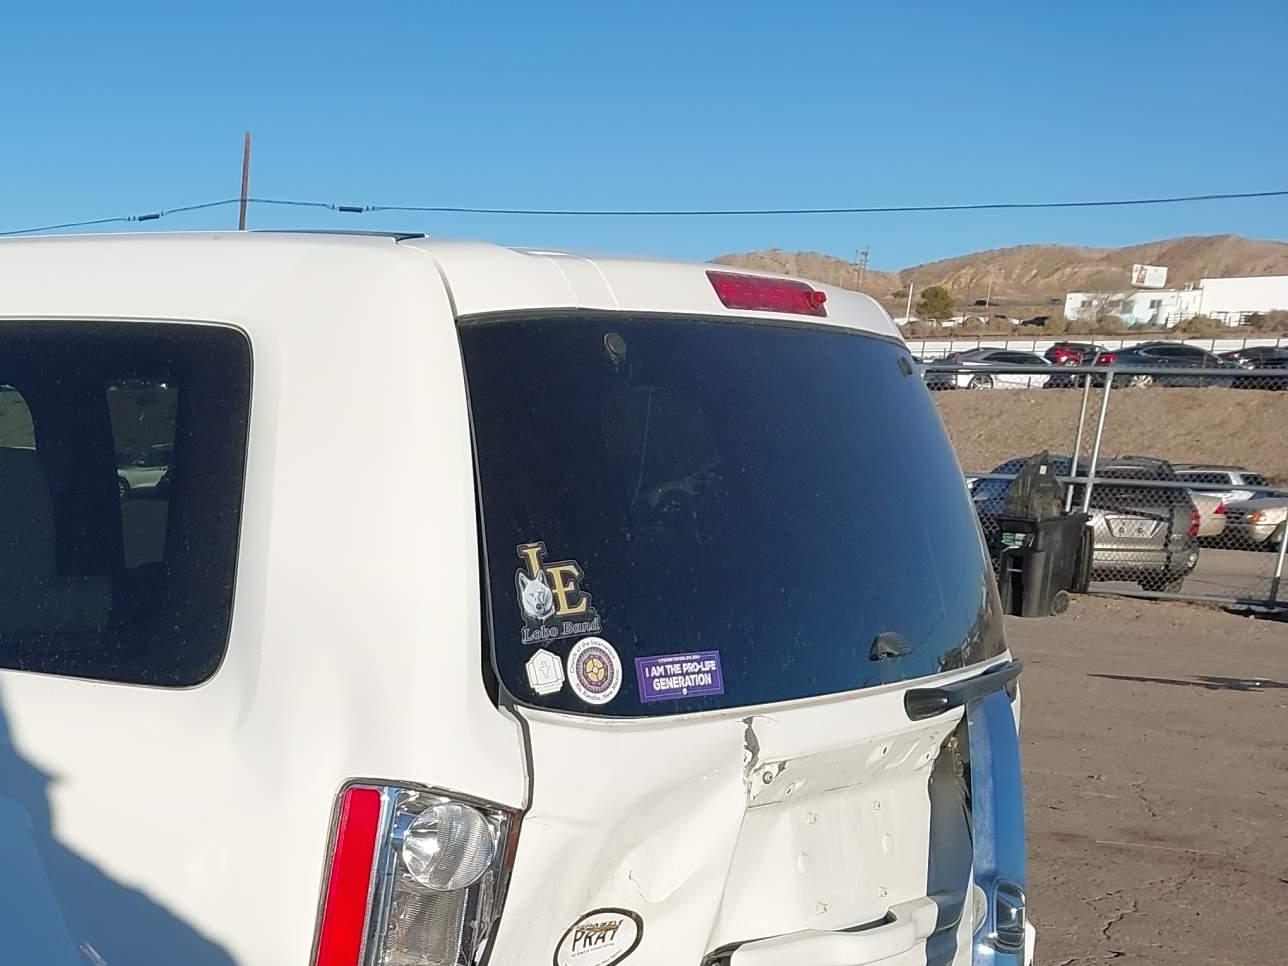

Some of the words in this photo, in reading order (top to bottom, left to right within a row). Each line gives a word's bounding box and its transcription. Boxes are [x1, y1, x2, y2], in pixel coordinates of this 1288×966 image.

[523, 624, 559, 643] Lobo
[562, 616, 601, 635] Band
[645, 667, 650, 678] I
[651, 665, 665, 677] AM
[665, 663, 682, 675] THE
[682, 660, 717, 673] PRO-LIFE
[653, 672, 712, 691] GENERATION
[572, 919, 625, 952] PRAY
